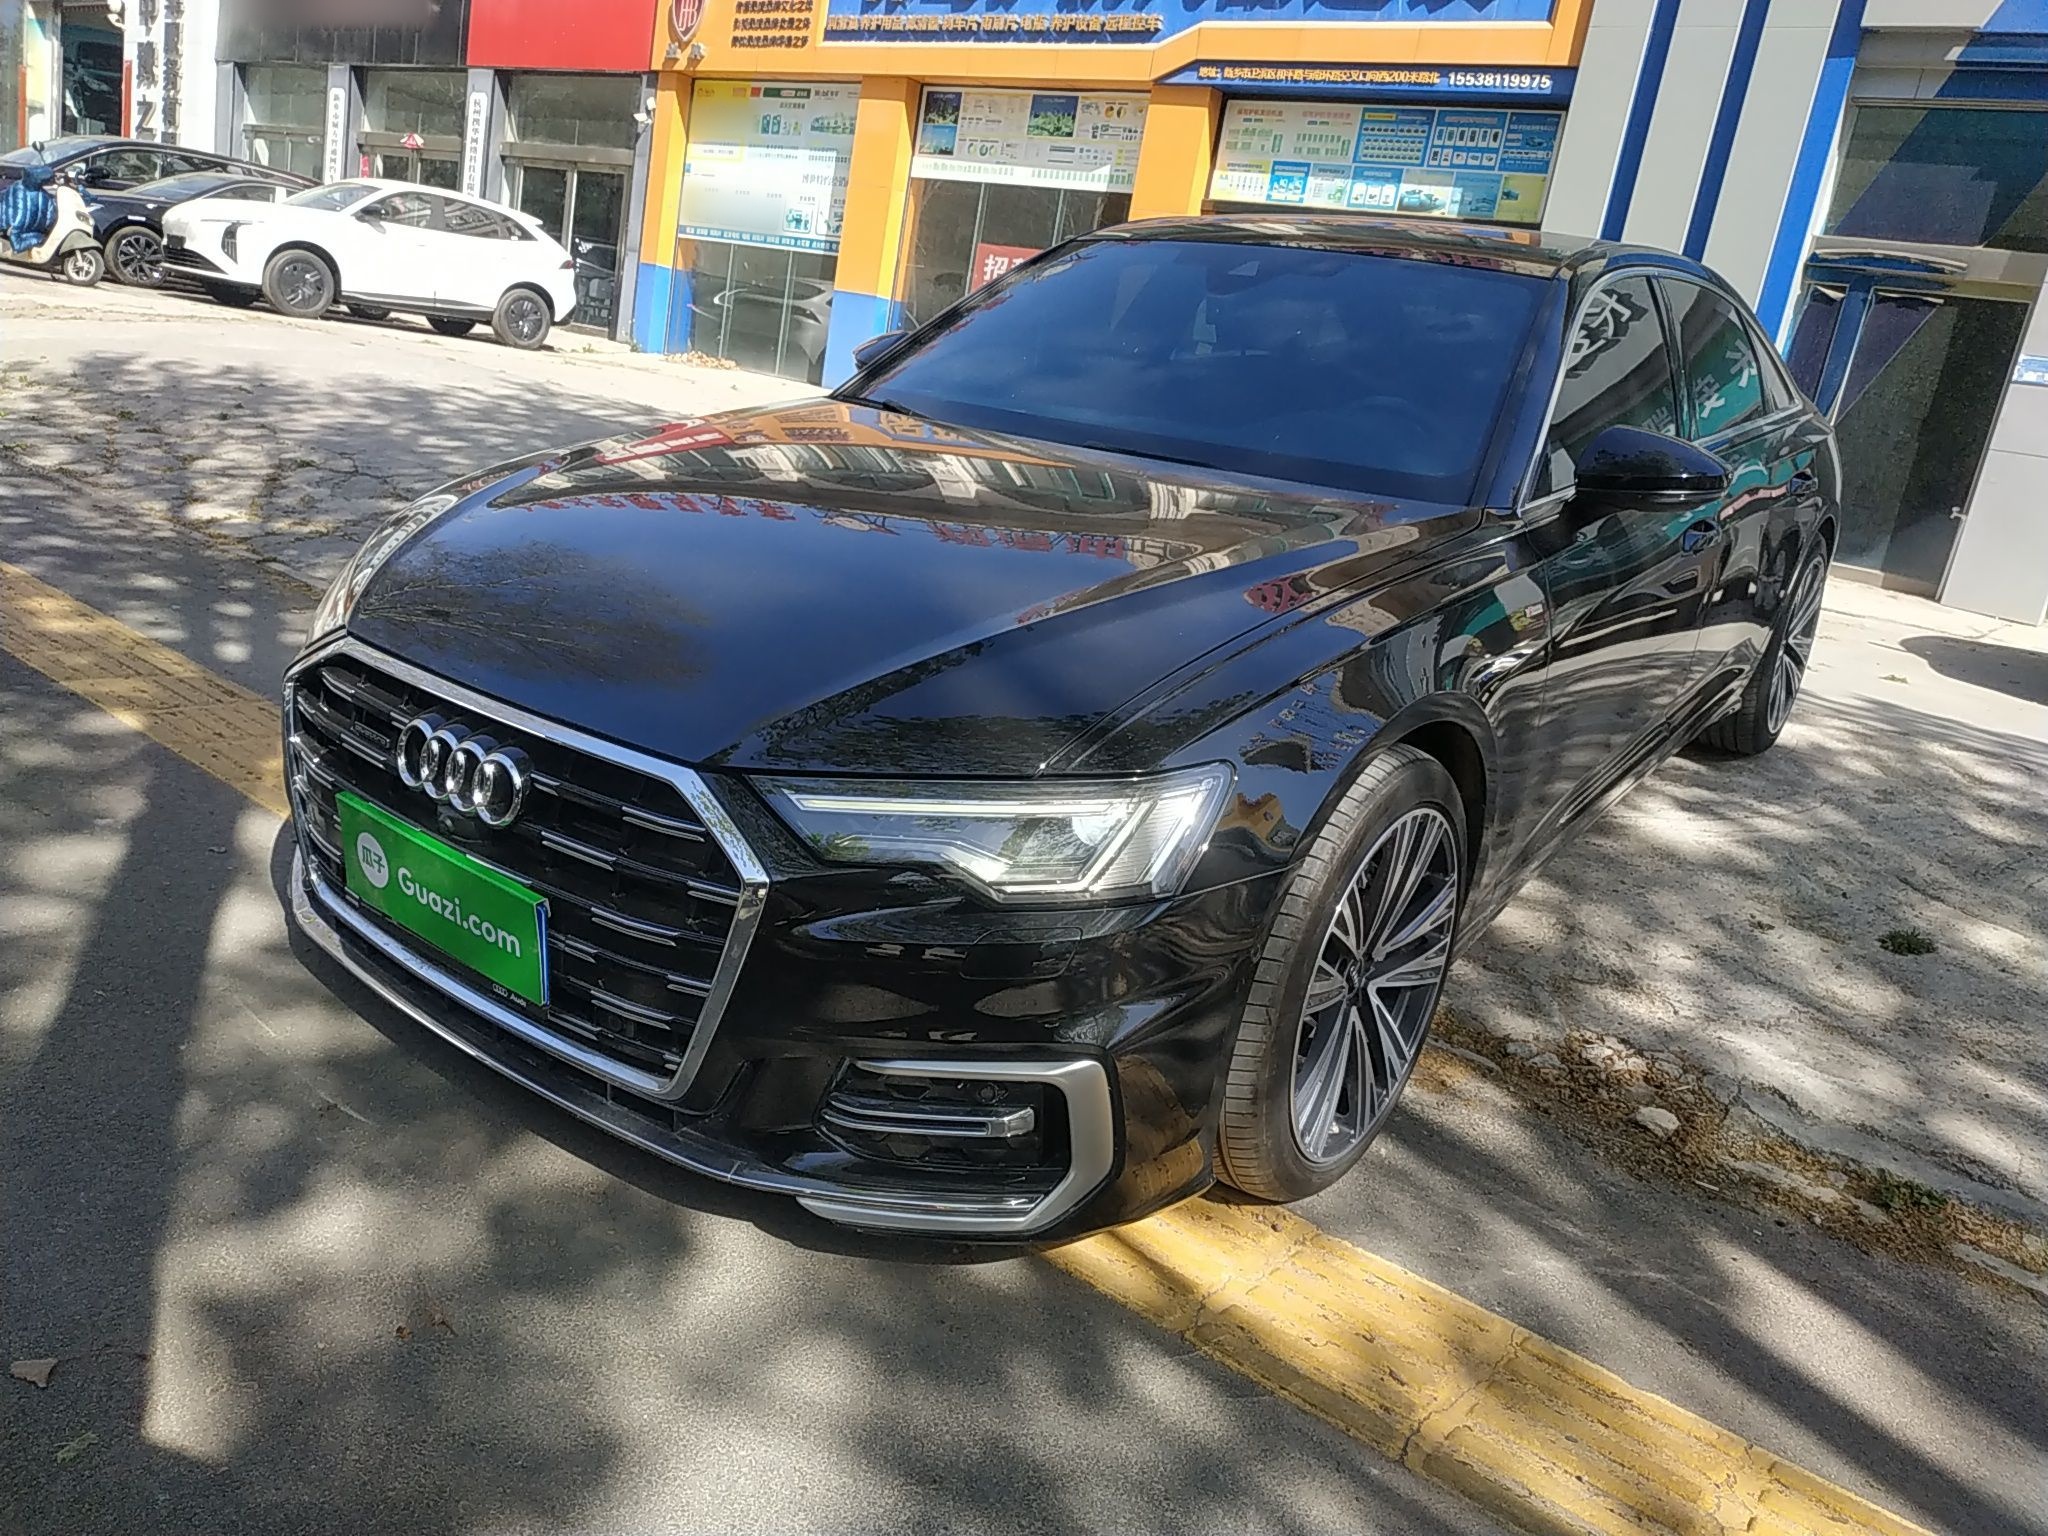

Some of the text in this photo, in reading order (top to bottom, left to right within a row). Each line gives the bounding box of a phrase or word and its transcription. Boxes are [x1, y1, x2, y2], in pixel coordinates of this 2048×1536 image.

[860, 14, 904, 31] 养护用品
[942, 14, 978, 31] 刹车片
[1020, 14, 1046, 31] 电瓶
[1050, 14, 1102, 31] 养护设备
[1448, 71, 1552, 89] 15538119975
[361, 843, 386, 875] 瓜子
[397, 866, 522, 959] Guazi.com
[510, 993, 527, 1008] Audi
